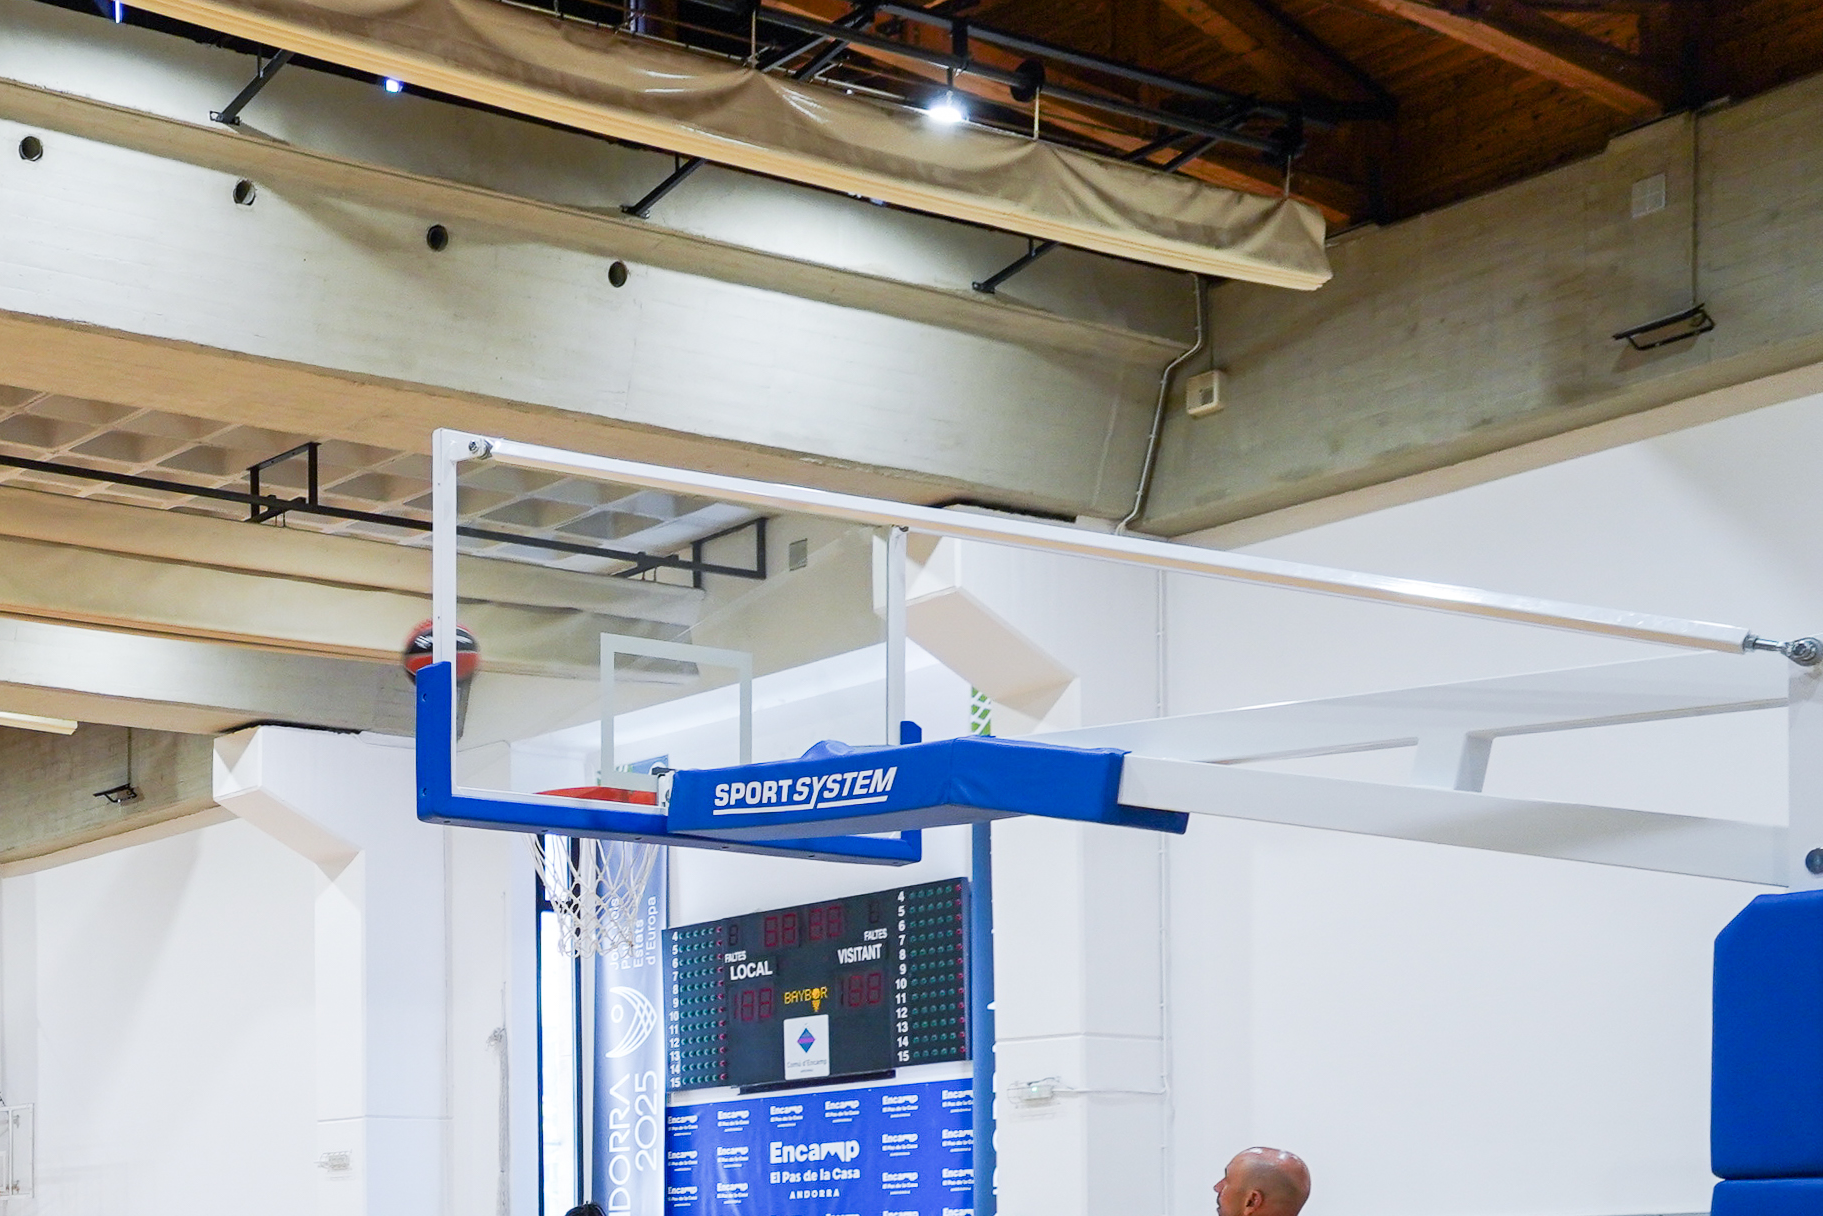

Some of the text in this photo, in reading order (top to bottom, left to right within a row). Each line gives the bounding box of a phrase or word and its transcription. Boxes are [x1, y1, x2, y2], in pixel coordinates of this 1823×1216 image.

[897, 891, 905, 901] 4
[898, 906, 905, 916] 5
[645, 896, 658, 965] d'Europa
[898, 920, 905, 931] 6
[672, 932, 678, 941] 4
[898, 935, 905, 945] 7
[633, 919, 644, 968] Estats
[672, 945, 678, 955] 5
[837, 943, 882, 965] VISITANT
[899, 950, 906, 960] 8
[672, 958, 678, 968] 6
[730, 960, 773, 981] LOCAL
[899, 964, 907, 974] 9
[672, 971, 678, 981] 7
[895, 978, 907, 989] 10
[673, 984, 678, 994] 8
[673, 998, 679, 1008] 9
[896, 993, 907, 1003] 11
[669, 1011, 679, 1021] 10
[896, 1008, 907, 1018] 12
[669, 1024, 679, 1034] 11
[896, 1022, 908, 1032] 13
[669, 1038, 680, 1048] 12
[897, 1036, 908, 1047] 14
[670, 1051, 680, 1061] 13
[897, 1051, 909, 1061] 15
[670, 1064, 680, 1074] 14
[670, 1077, 681, 1087] 15
[635, 1070, 658, 1172] 2025
[770, 1140, 860, 1164] Encamp
[770, 1167, 860, 1184] El Pas de la Casa
[789, 1188, 840, 1200] ANDORRA
